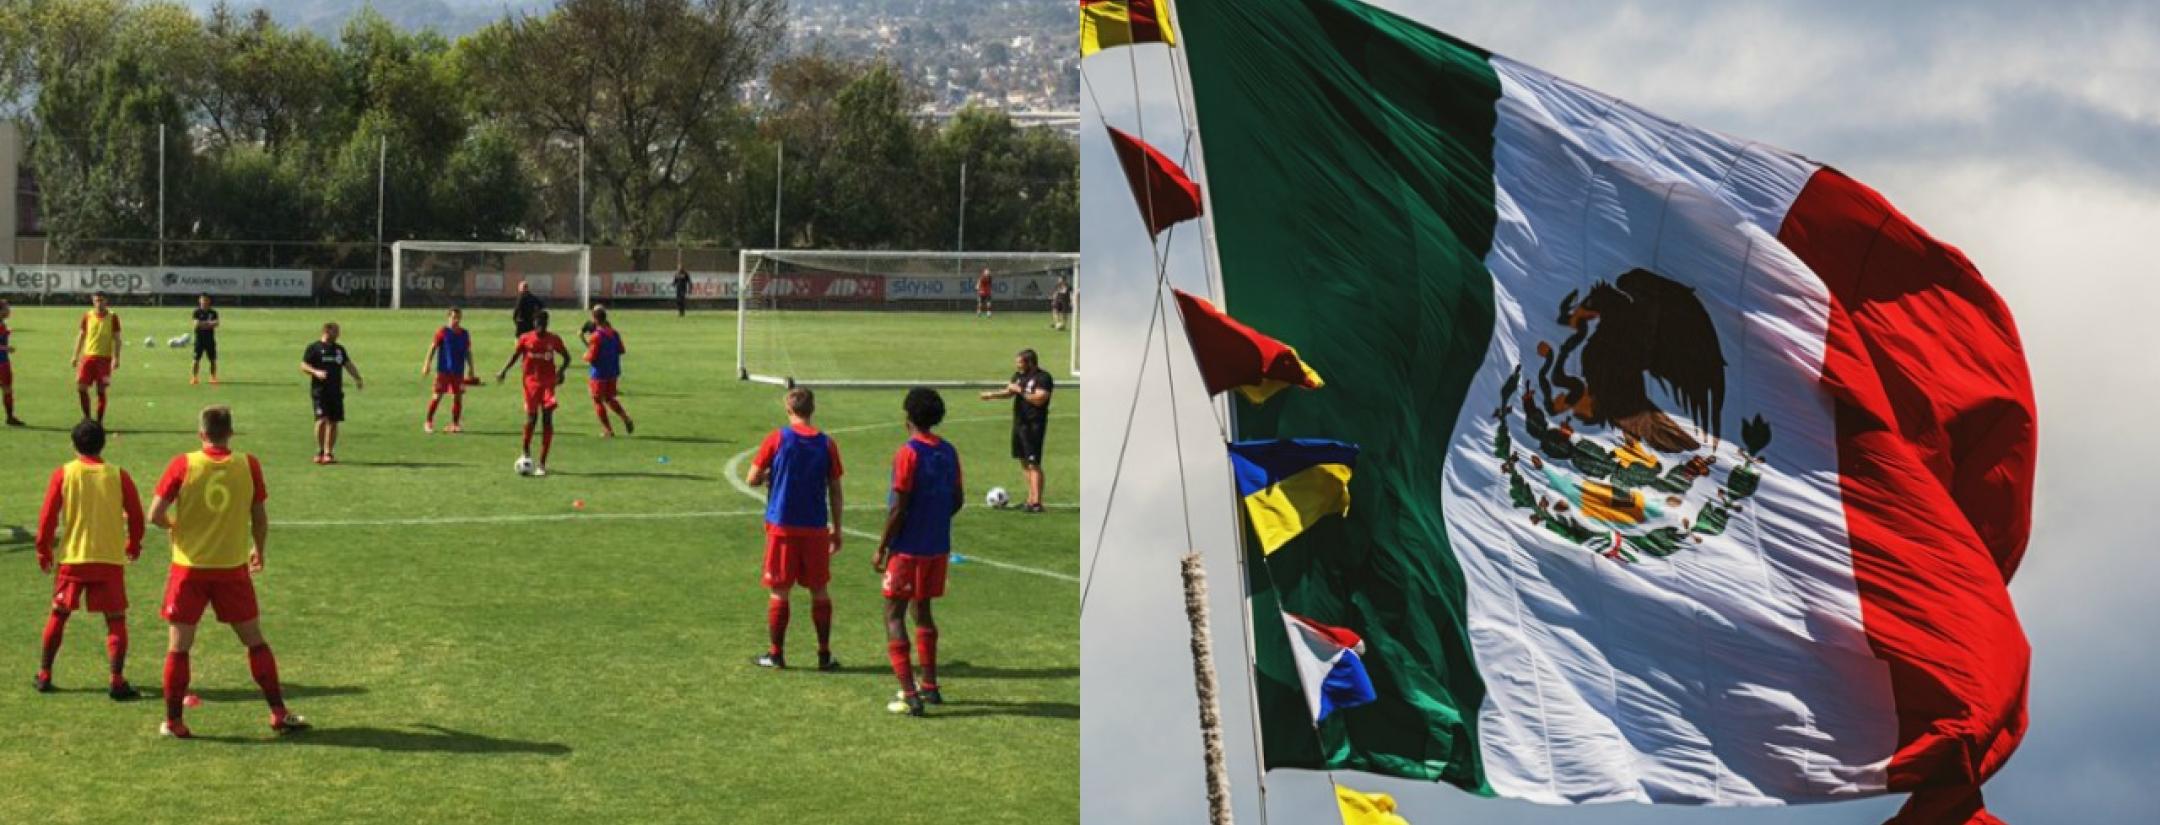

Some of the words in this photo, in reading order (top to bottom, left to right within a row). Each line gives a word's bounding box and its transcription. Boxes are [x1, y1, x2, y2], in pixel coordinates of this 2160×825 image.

[0, 266, 61, 293] Jeep
[80, 268, 143, 293] Jeep
[264, 278, 305, 288] DELTA
[205, 470, 231, 512] 6
